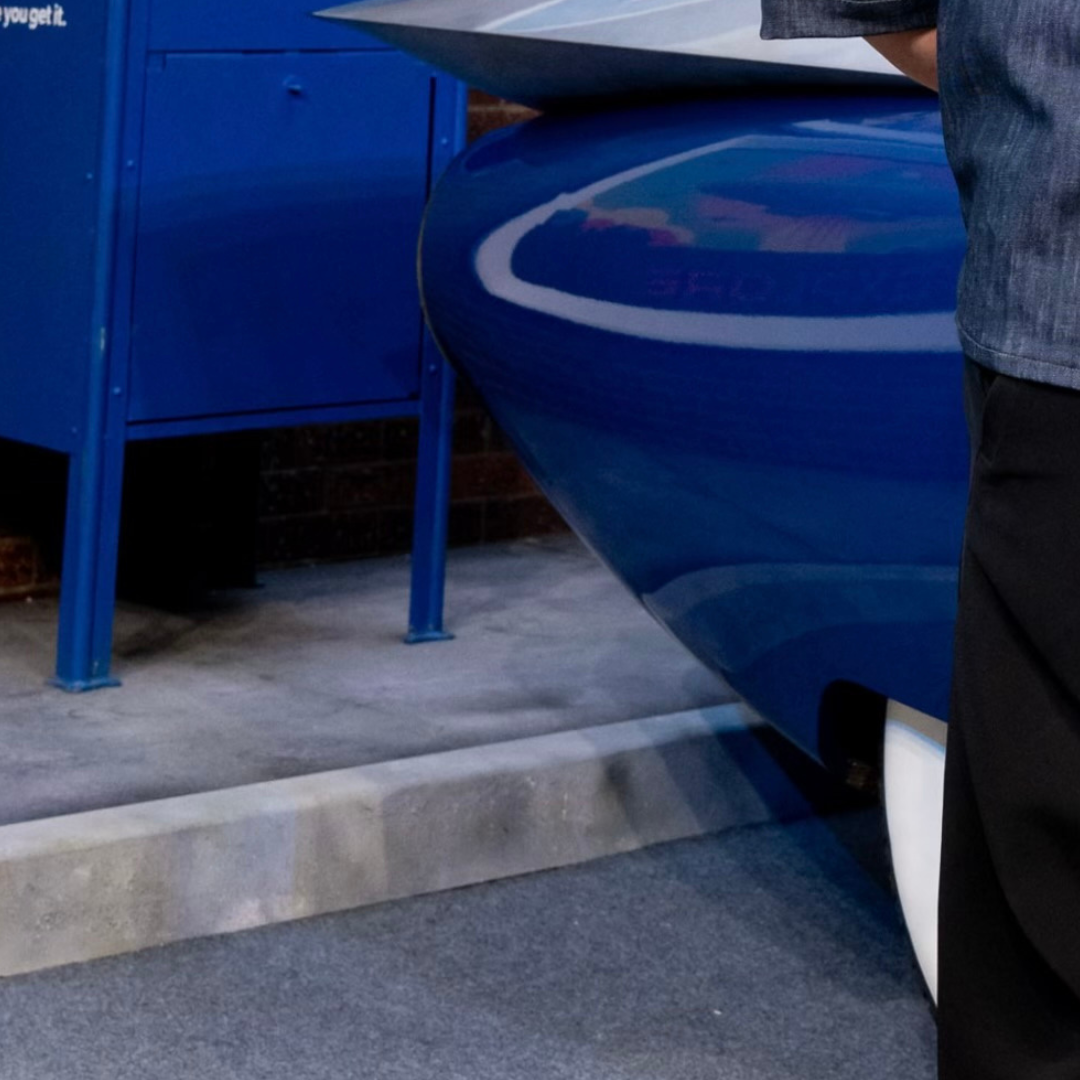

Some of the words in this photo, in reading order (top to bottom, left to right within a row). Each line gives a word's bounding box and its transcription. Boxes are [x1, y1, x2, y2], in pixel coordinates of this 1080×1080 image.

[3, 6, 28, 28] you
[28, 4, 52, 30] get
[53, 3, 67, 27] it.
